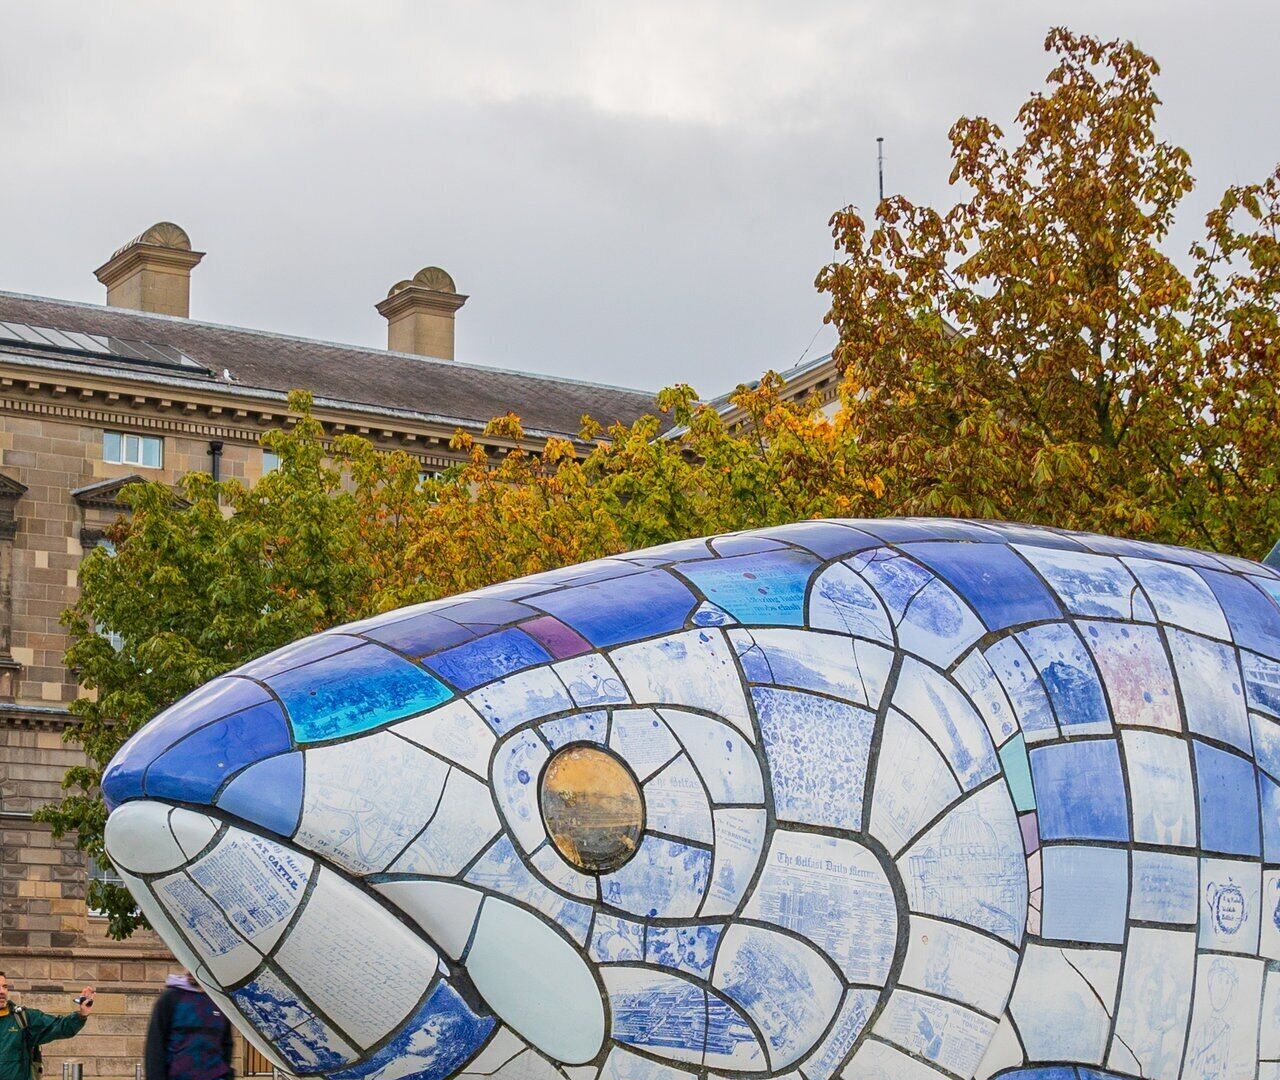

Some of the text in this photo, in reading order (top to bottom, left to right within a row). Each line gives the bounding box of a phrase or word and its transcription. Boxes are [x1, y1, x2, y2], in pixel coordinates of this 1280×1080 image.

[317, 839, 330, 848] OF
[333, 847, 350, 859] THE
[268, 855, 299, 890] CATTLE
[777, 851, 793, 867] The
[795, 854, 823, 872] Belfast
[825, 859, 848, 875] Daily
